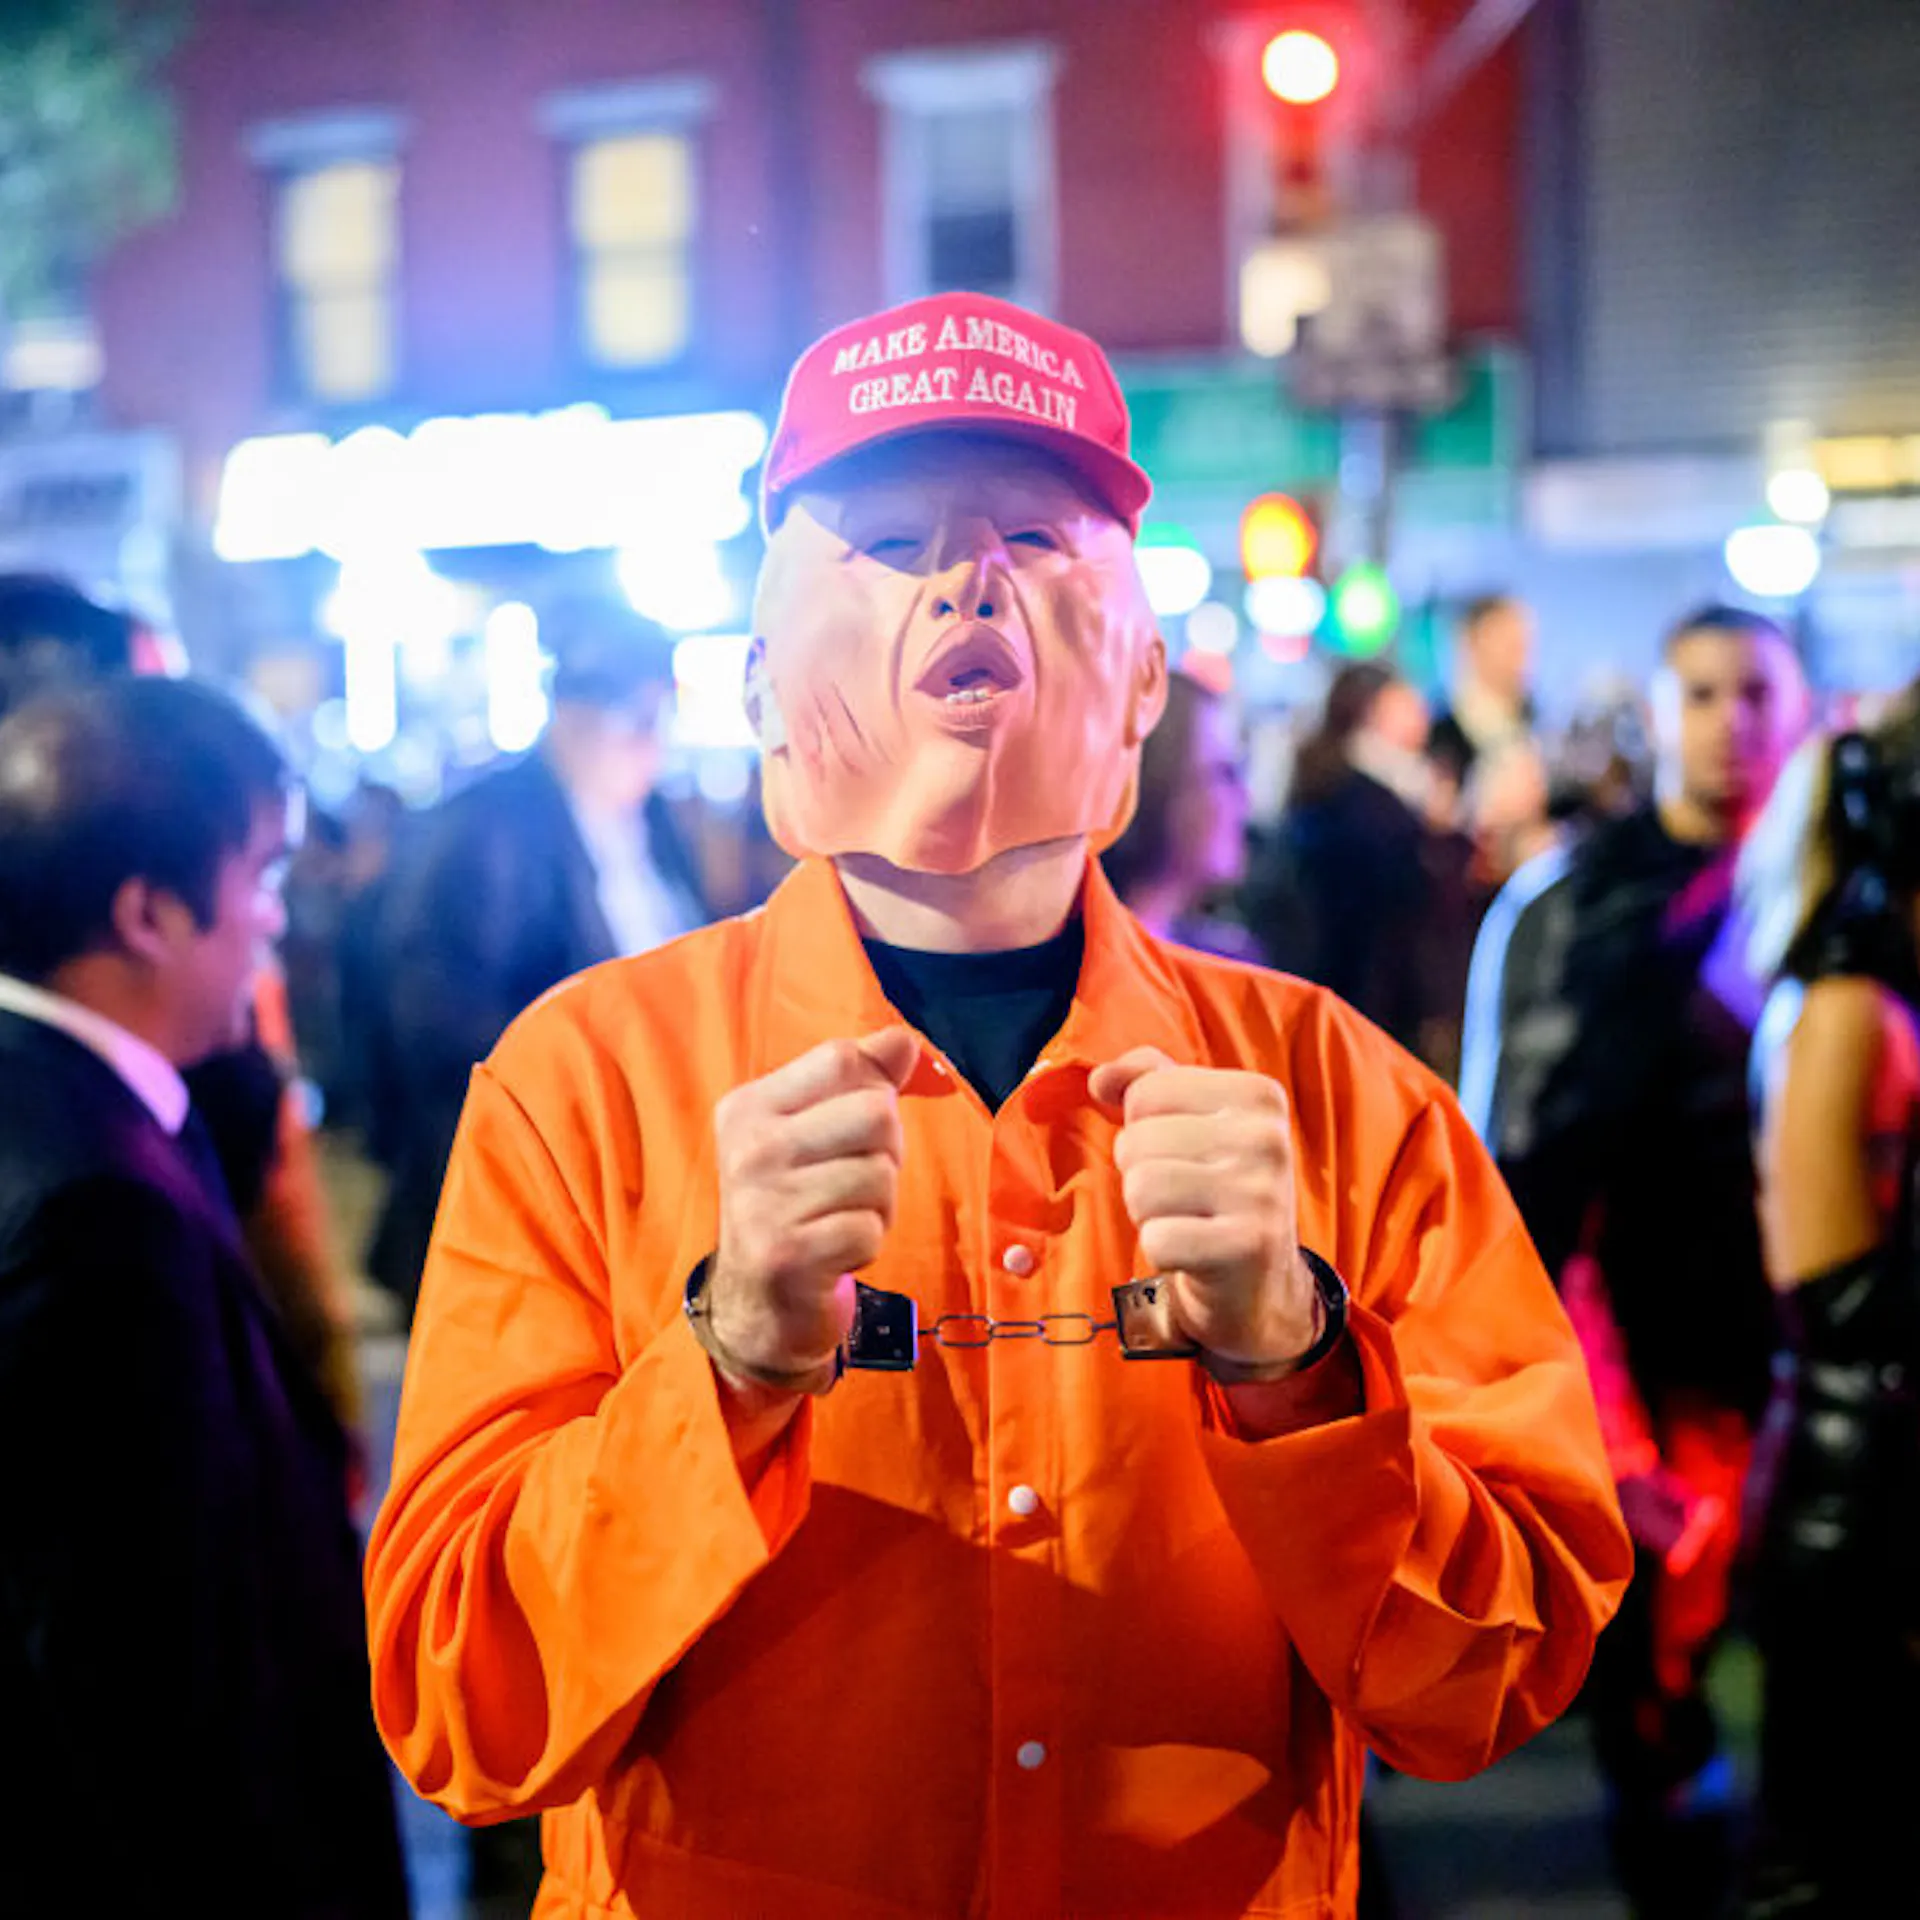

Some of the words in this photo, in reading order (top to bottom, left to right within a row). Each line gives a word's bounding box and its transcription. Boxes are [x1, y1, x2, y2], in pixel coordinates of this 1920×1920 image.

[833, 323, 927, 374] MAKE
[935, 316, 1084, 388] AMERICA
[850, 367, 958, 413] GREAT
[966, 368, 1077, 428] AGAIN
